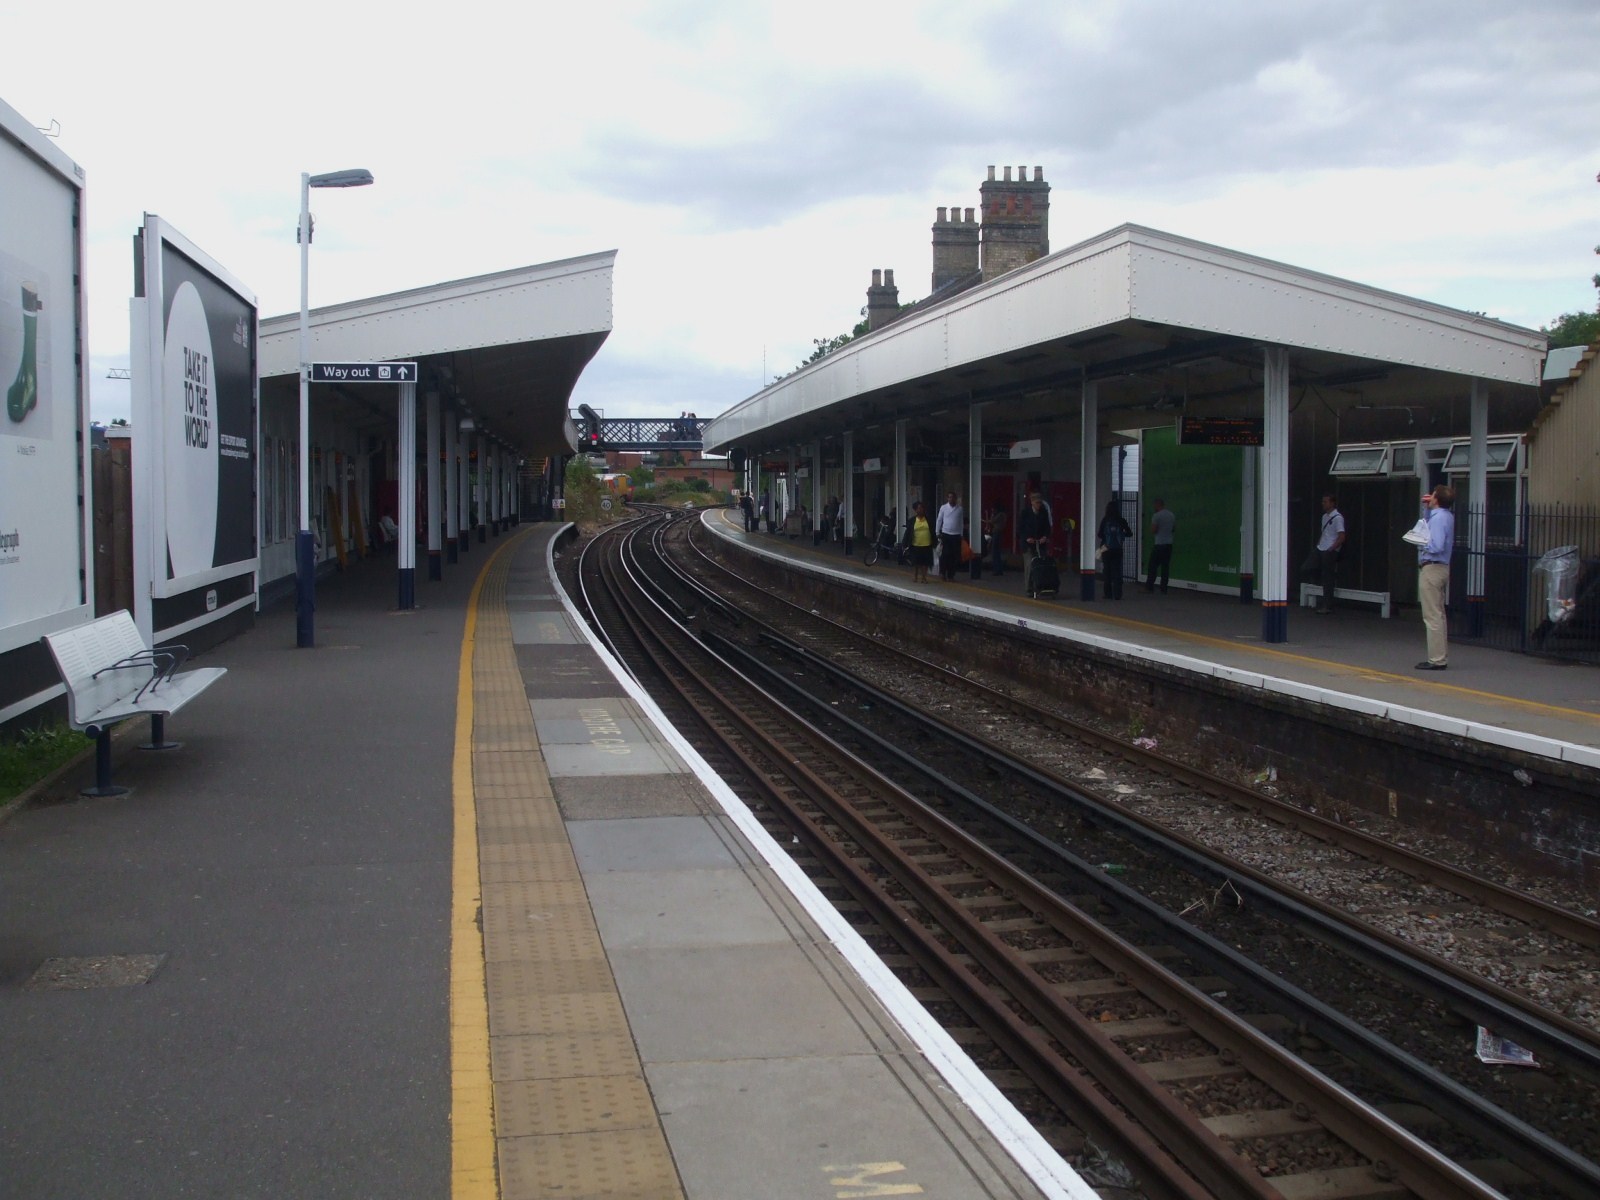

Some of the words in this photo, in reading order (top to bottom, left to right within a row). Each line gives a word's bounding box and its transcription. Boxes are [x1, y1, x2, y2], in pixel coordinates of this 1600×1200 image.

[184, 346, 201, 383] TAKE
[202, 355, 208, 385] IT
[323, 366, 348, 379] Way
[351, 367, 370, 377] out
[184, 381, 194, 413] TO
[196, 385, 208, 417] THE
[184, 414, 209, 449] WORLD
